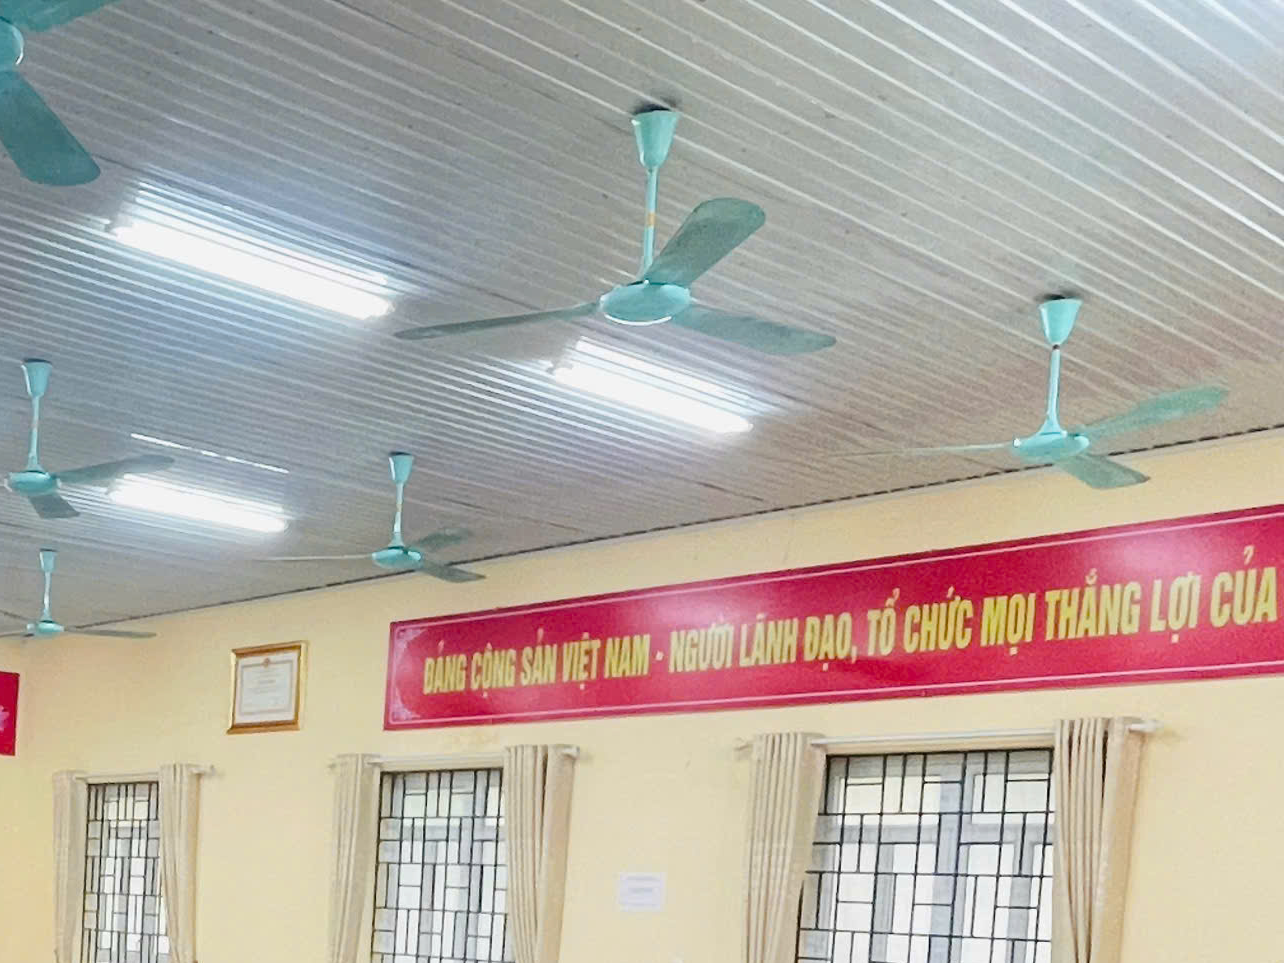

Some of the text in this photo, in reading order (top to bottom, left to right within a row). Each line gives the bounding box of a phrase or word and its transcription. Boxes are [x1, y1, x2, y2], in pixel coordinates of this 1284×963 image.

[562, 631, 601, 690] VIỆT
[604, 634, 651, 679] NAM
[739, 613, 798, 667] LÃNH
[804, 612, 857, 672] ĐẠO,
[867, 587, 900, 656] TỔ
[903, 586, 973, 653] CHỨC
[980, 592, 1037, 656] MỌI
[1044, 567, 1141, 642] THẮNG
[1150, 572, 1202, 643] LỢI
[1210, 545, 1278, 628] CỦA
